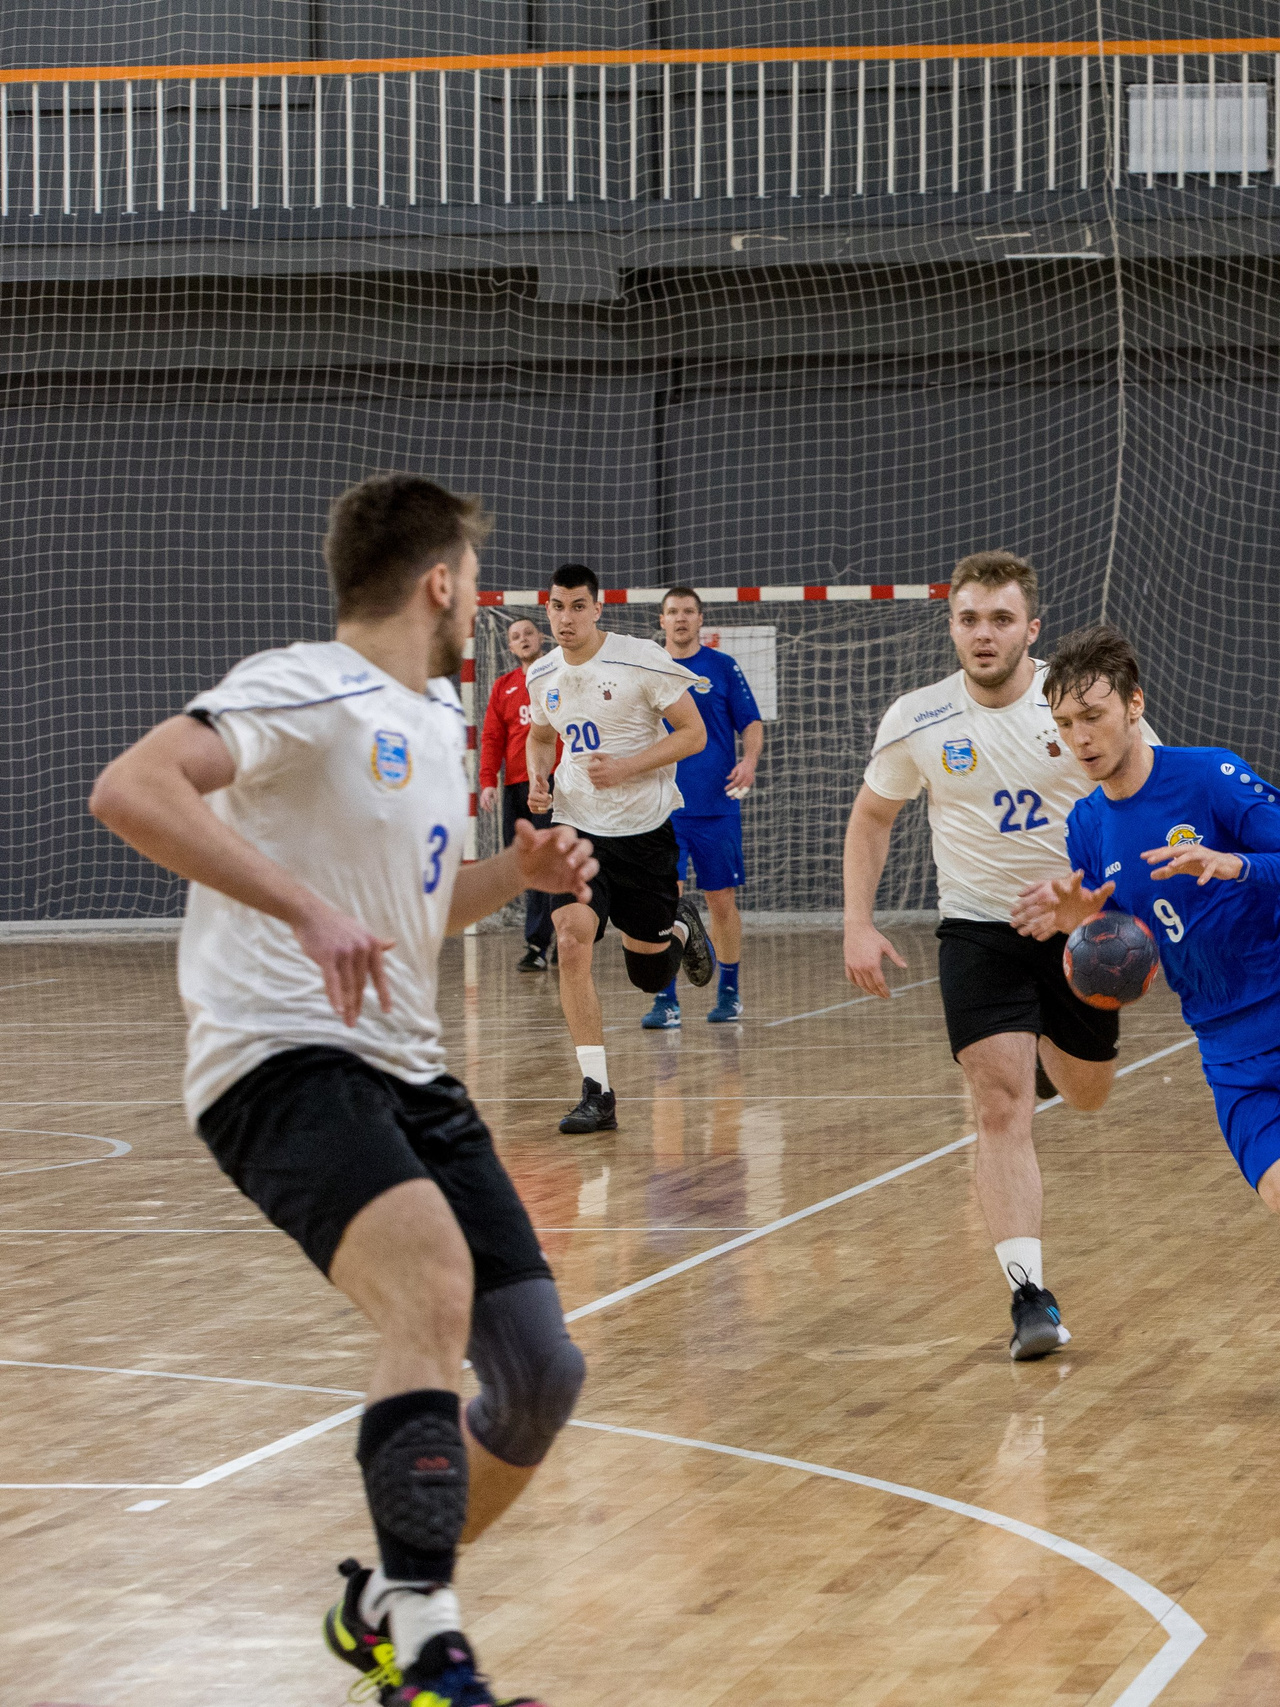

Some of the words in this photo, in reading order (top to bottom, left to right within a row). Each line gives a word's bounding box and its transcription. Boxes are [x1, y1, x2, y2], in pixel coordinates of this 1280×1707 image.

[519, 704, 532, 726] 9
[914, 702, 953, 723] uhlsport
[566, 721, 600, 752] 20
[994, 789, 1049, 833] 22
[423, 824, 448, 894] 3
[1153, 899, 1184, 943] 9
